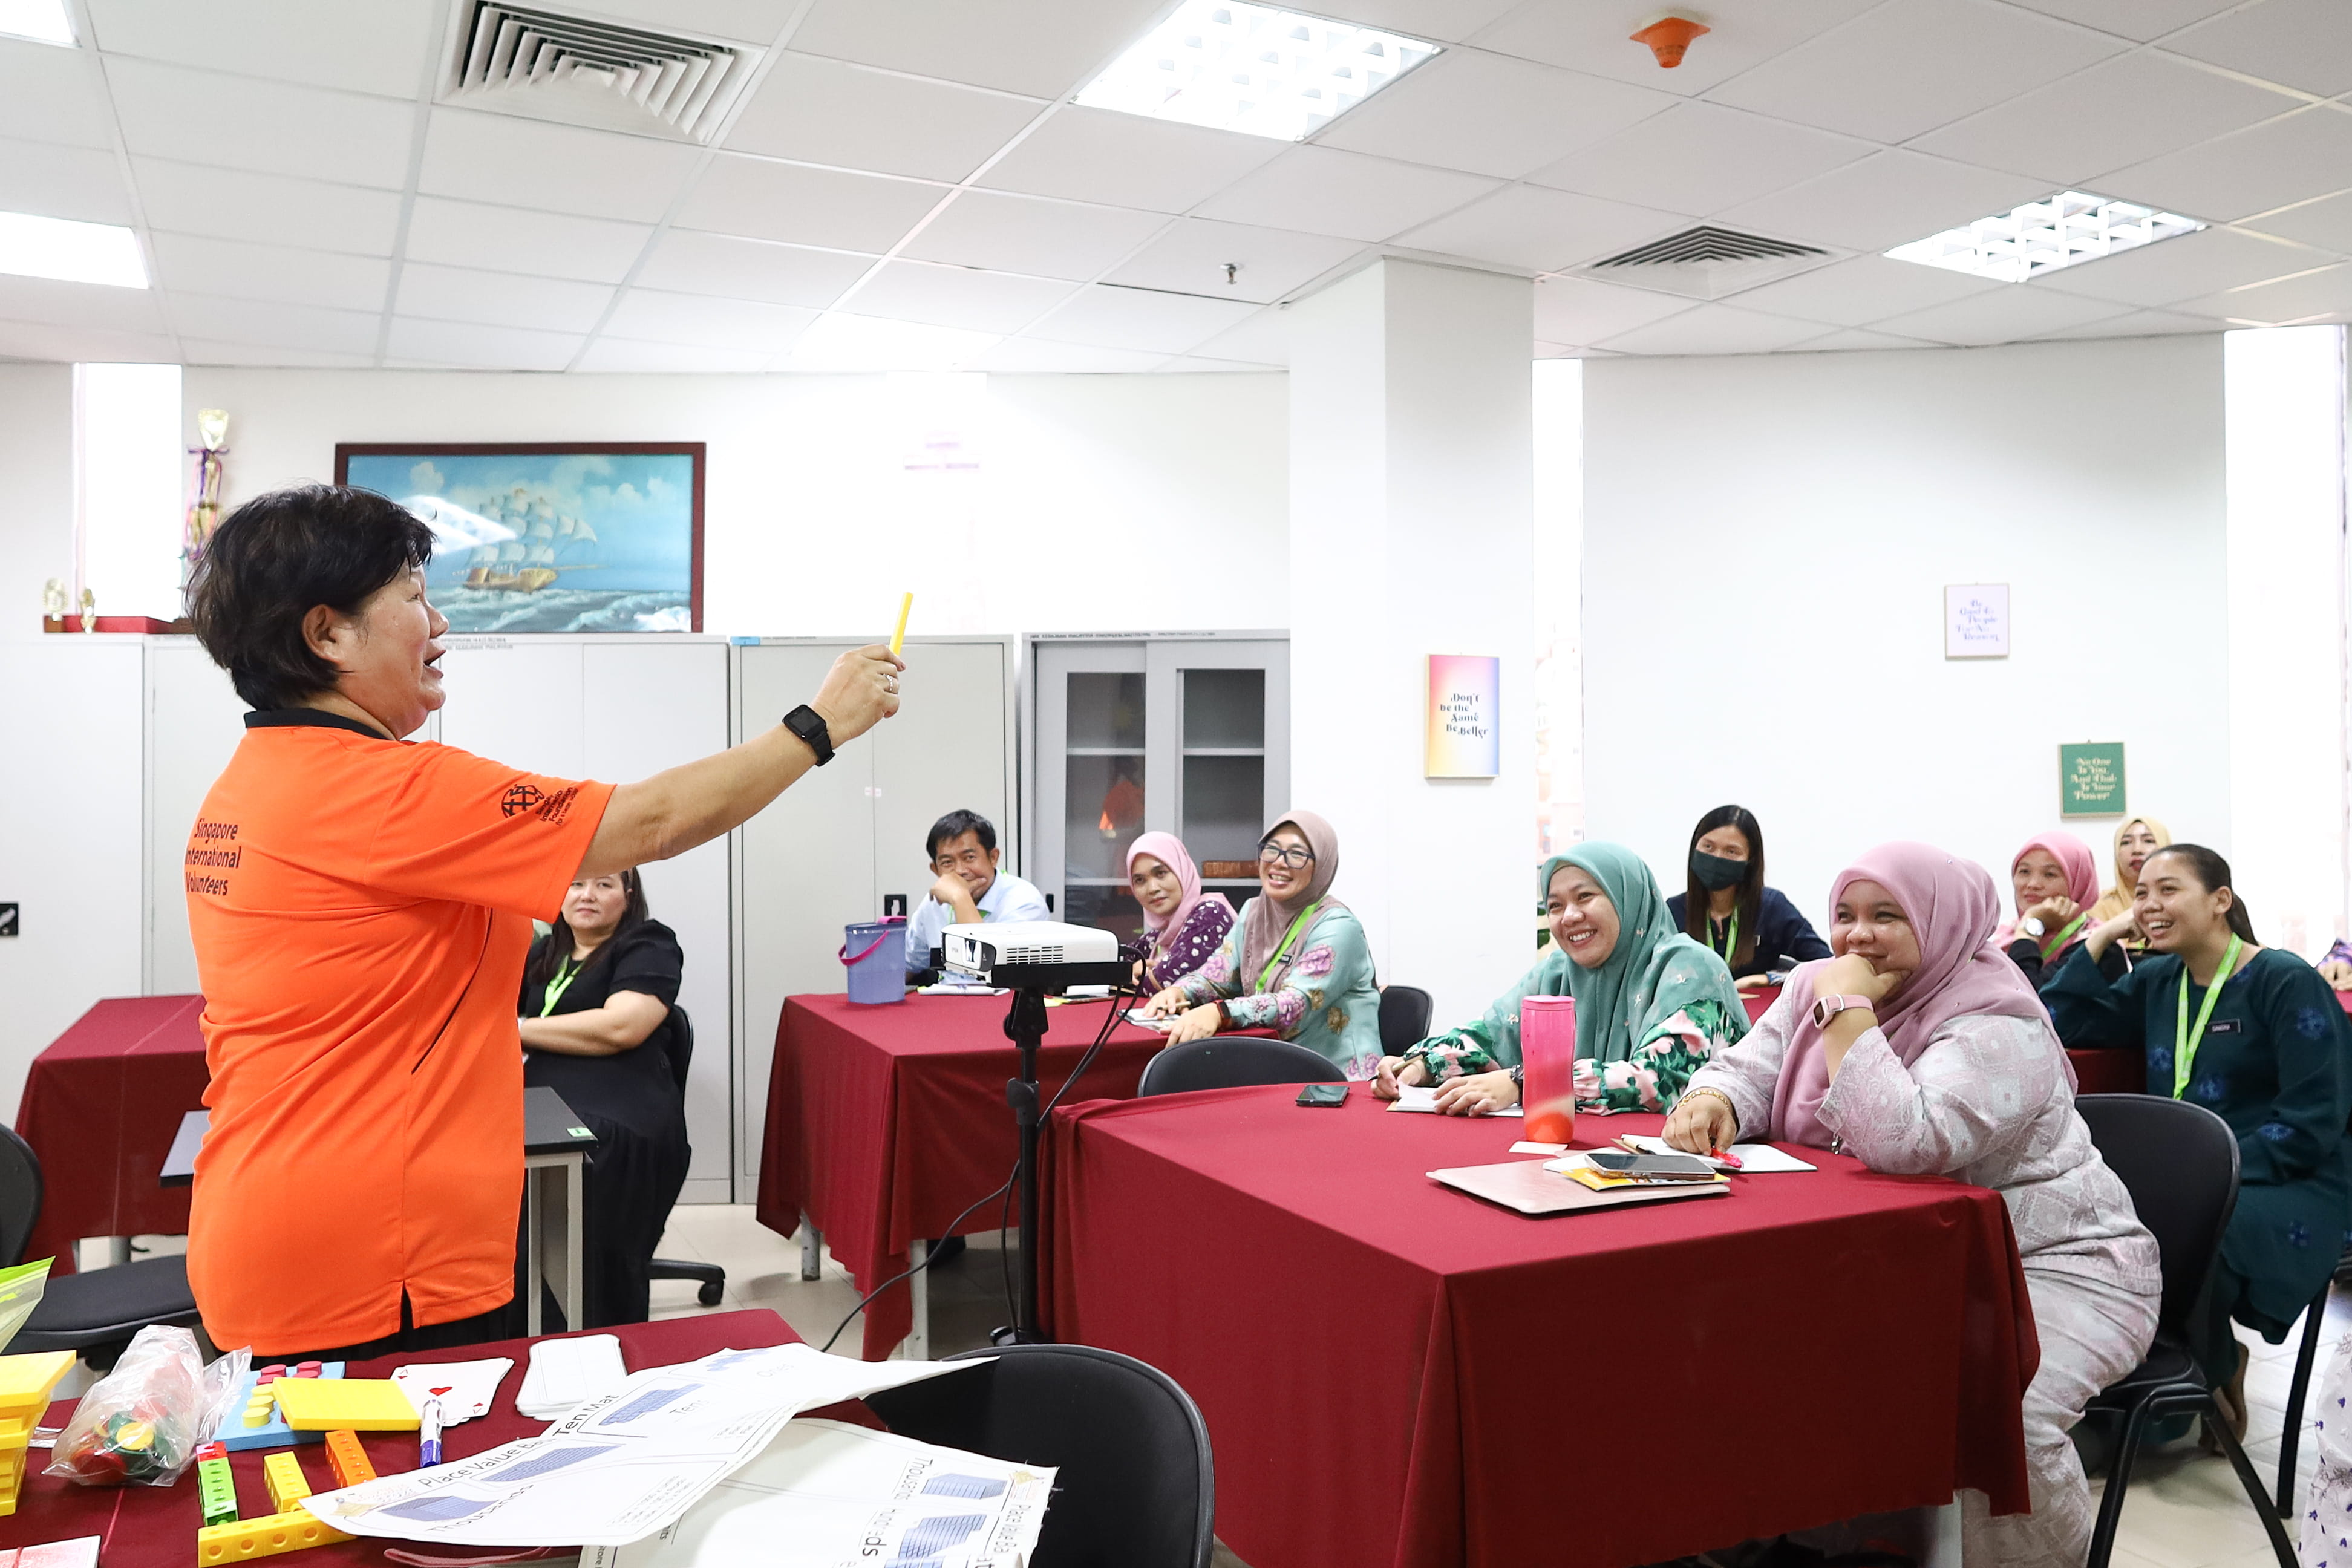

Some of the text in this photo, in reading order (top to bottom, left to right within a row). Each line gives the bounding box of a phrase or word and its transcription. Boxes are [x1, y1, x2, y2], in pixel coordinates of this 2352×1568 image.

[1451, 693, 1480, 706] Don't
[1451, 712, 1479, 723] Same
[1458, 725, 1488, 739] Better
[2092, 757, 2111, 766] One
[2074, 791, 2111, 800] Power
[194, 817, 238, 844] Singapore
[185, 871, 229, 896] Volunteers
[668, 1399, 710, 1414] Tens
[418, 1468, 473, 1488] Place
[465, 1448, 521, 1471] Value
[552, 1413, 588, 1437] Ten
[582, 1394, 621, 1413] Mat
